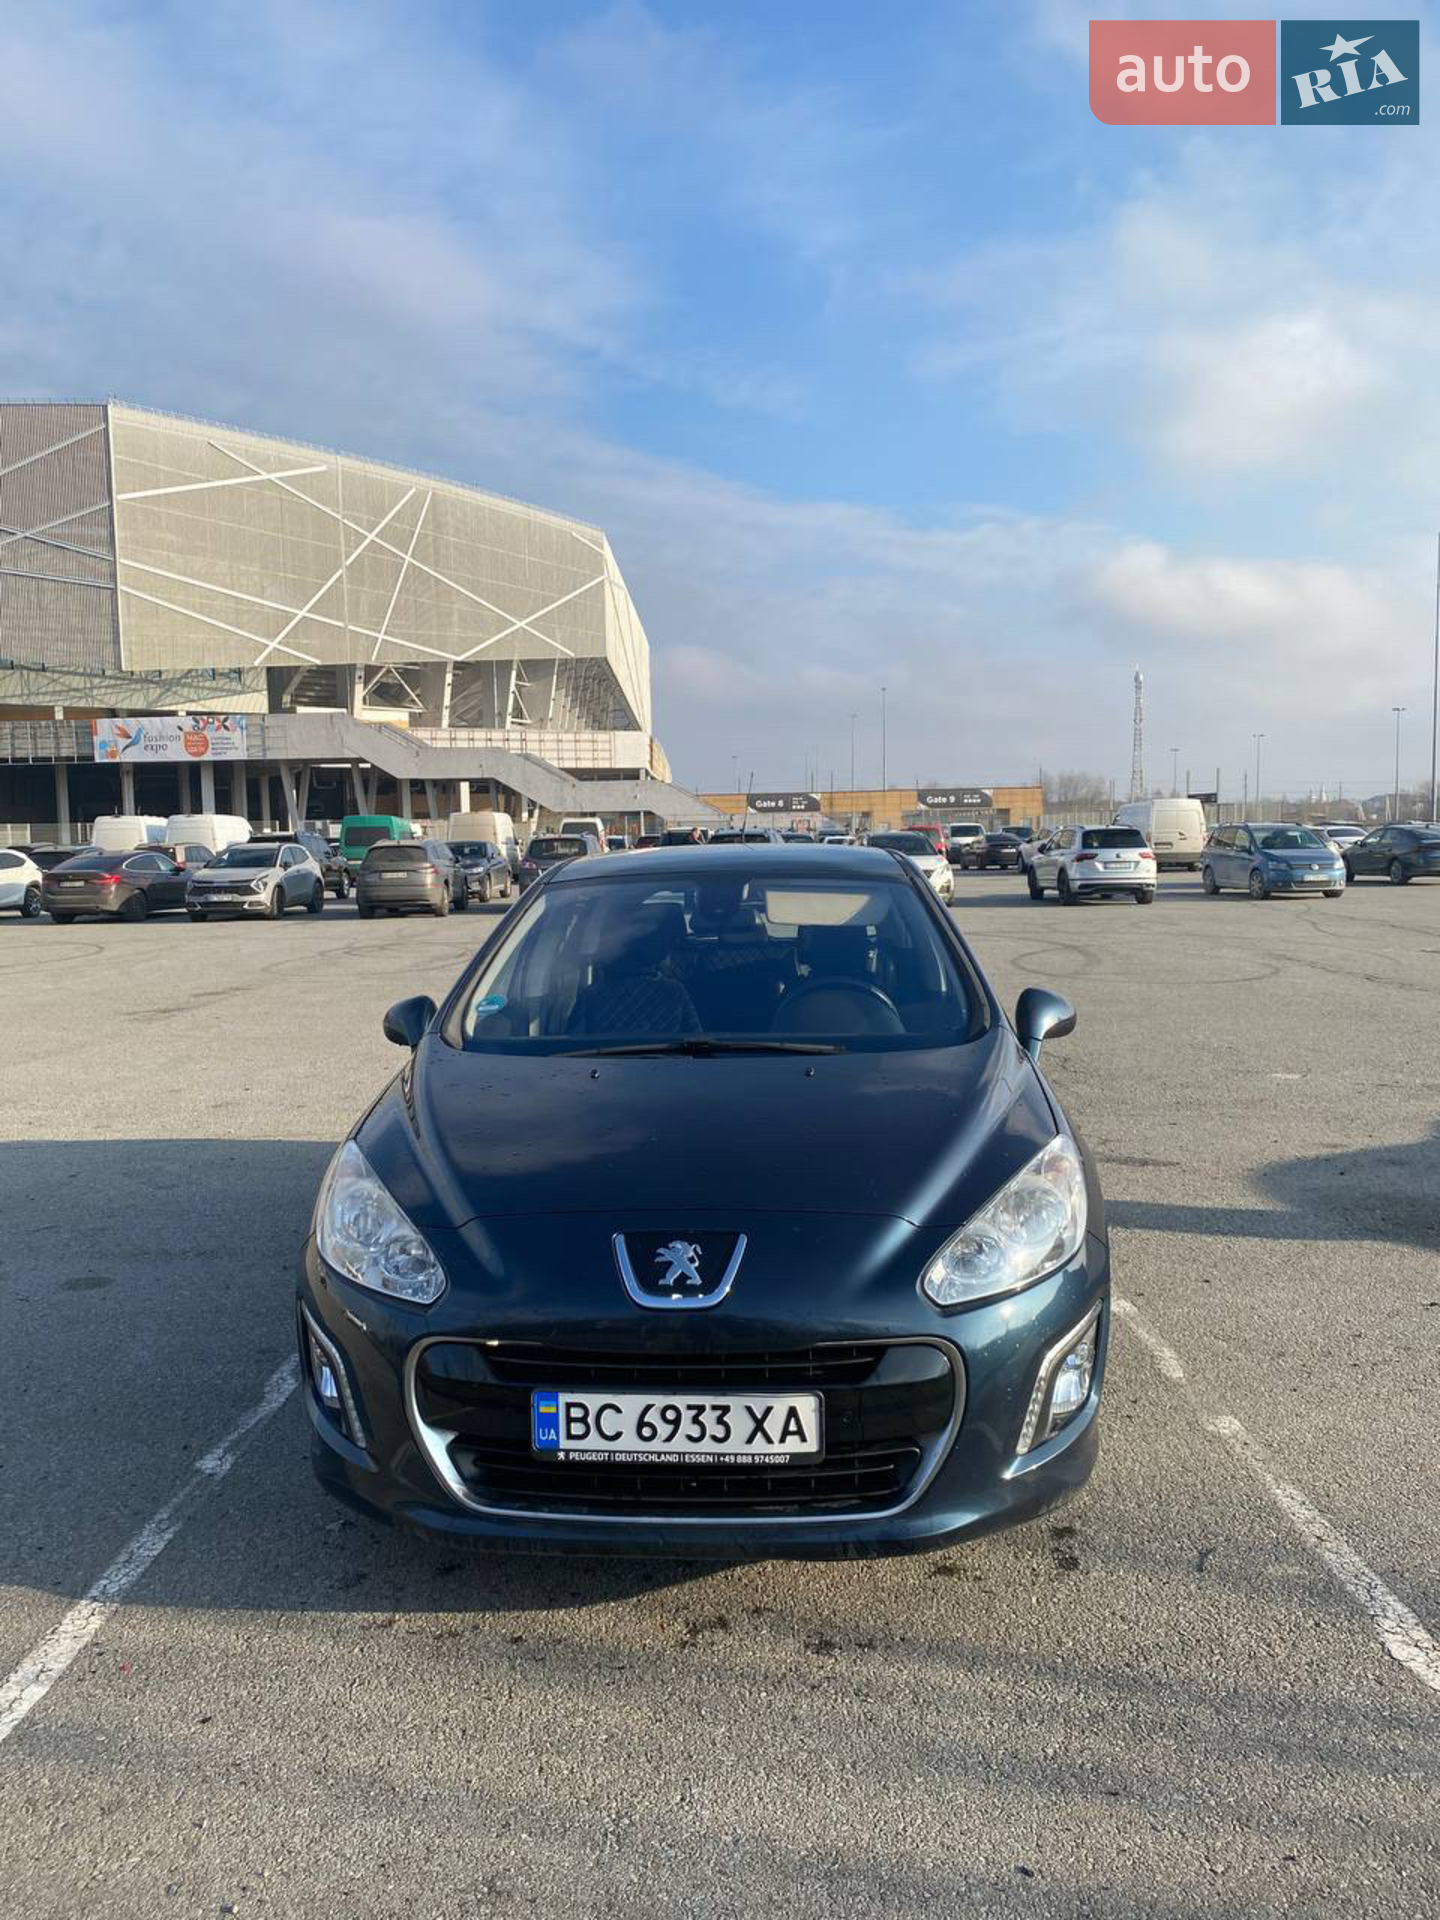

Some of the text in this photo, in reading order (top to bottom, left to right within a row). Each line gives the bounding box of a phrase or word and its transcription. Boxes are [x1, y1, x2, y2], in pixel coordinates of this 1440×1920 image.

[143, 731, 181, 743] fashion
[143, 743, 168, 753] expo
[755, 800, 775, 808] Gate
[926, 795, 947, 804] Gate
[949, 794, 956, 804] 9
[565, 1401, 808, 1445] BC 6933 XA
[539, 1428, 557, 1441] UA
[569, 1451, 609, 1461] PEUGEOT
[614, 1452, 679, 1463] DEUTSCHLAND
[685, 1454, 713, 1464] ESSEN
[720, 1454, 735, 1464] +49
[754, 1454, 790, 1464] 9745007
